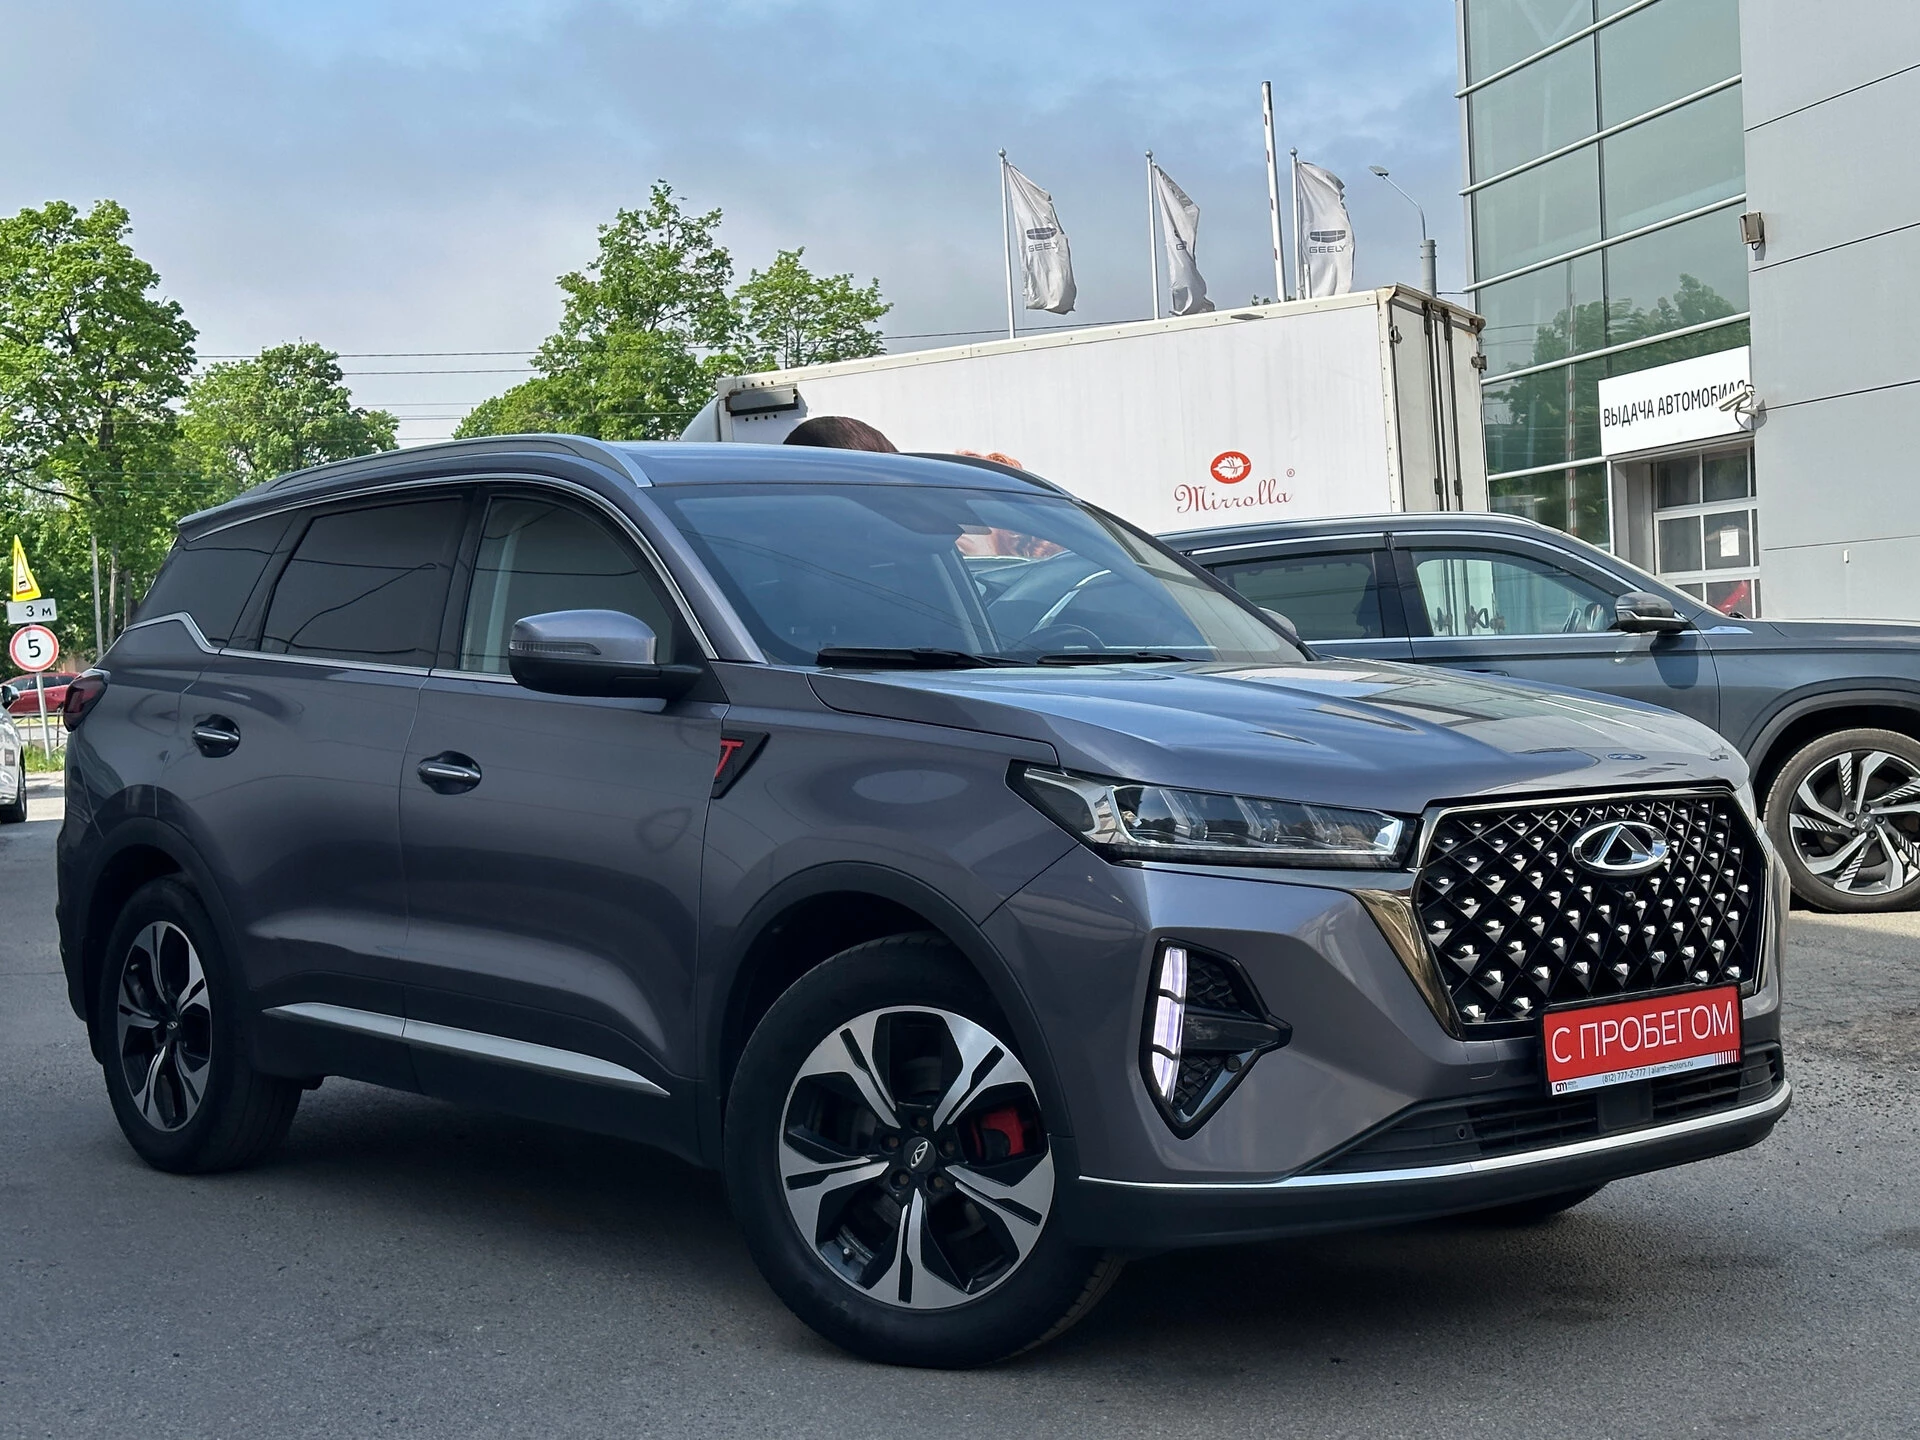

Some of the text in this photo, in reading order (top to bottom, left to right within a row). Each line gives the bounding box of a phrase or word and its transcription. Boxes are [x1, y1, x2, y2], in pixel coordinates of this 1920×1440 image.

[1309, 245, 1346, 254] GEELY
[1603, 398, 1655, 428] ВЫДАЧА
[1174, 478, 1293, 514] Mirrolla
[26, 605, 35, 617] 3
[28, 639, 42, 658] 5
[1551, 1000, 1734, 1064] С ПРОБЕГОМ
